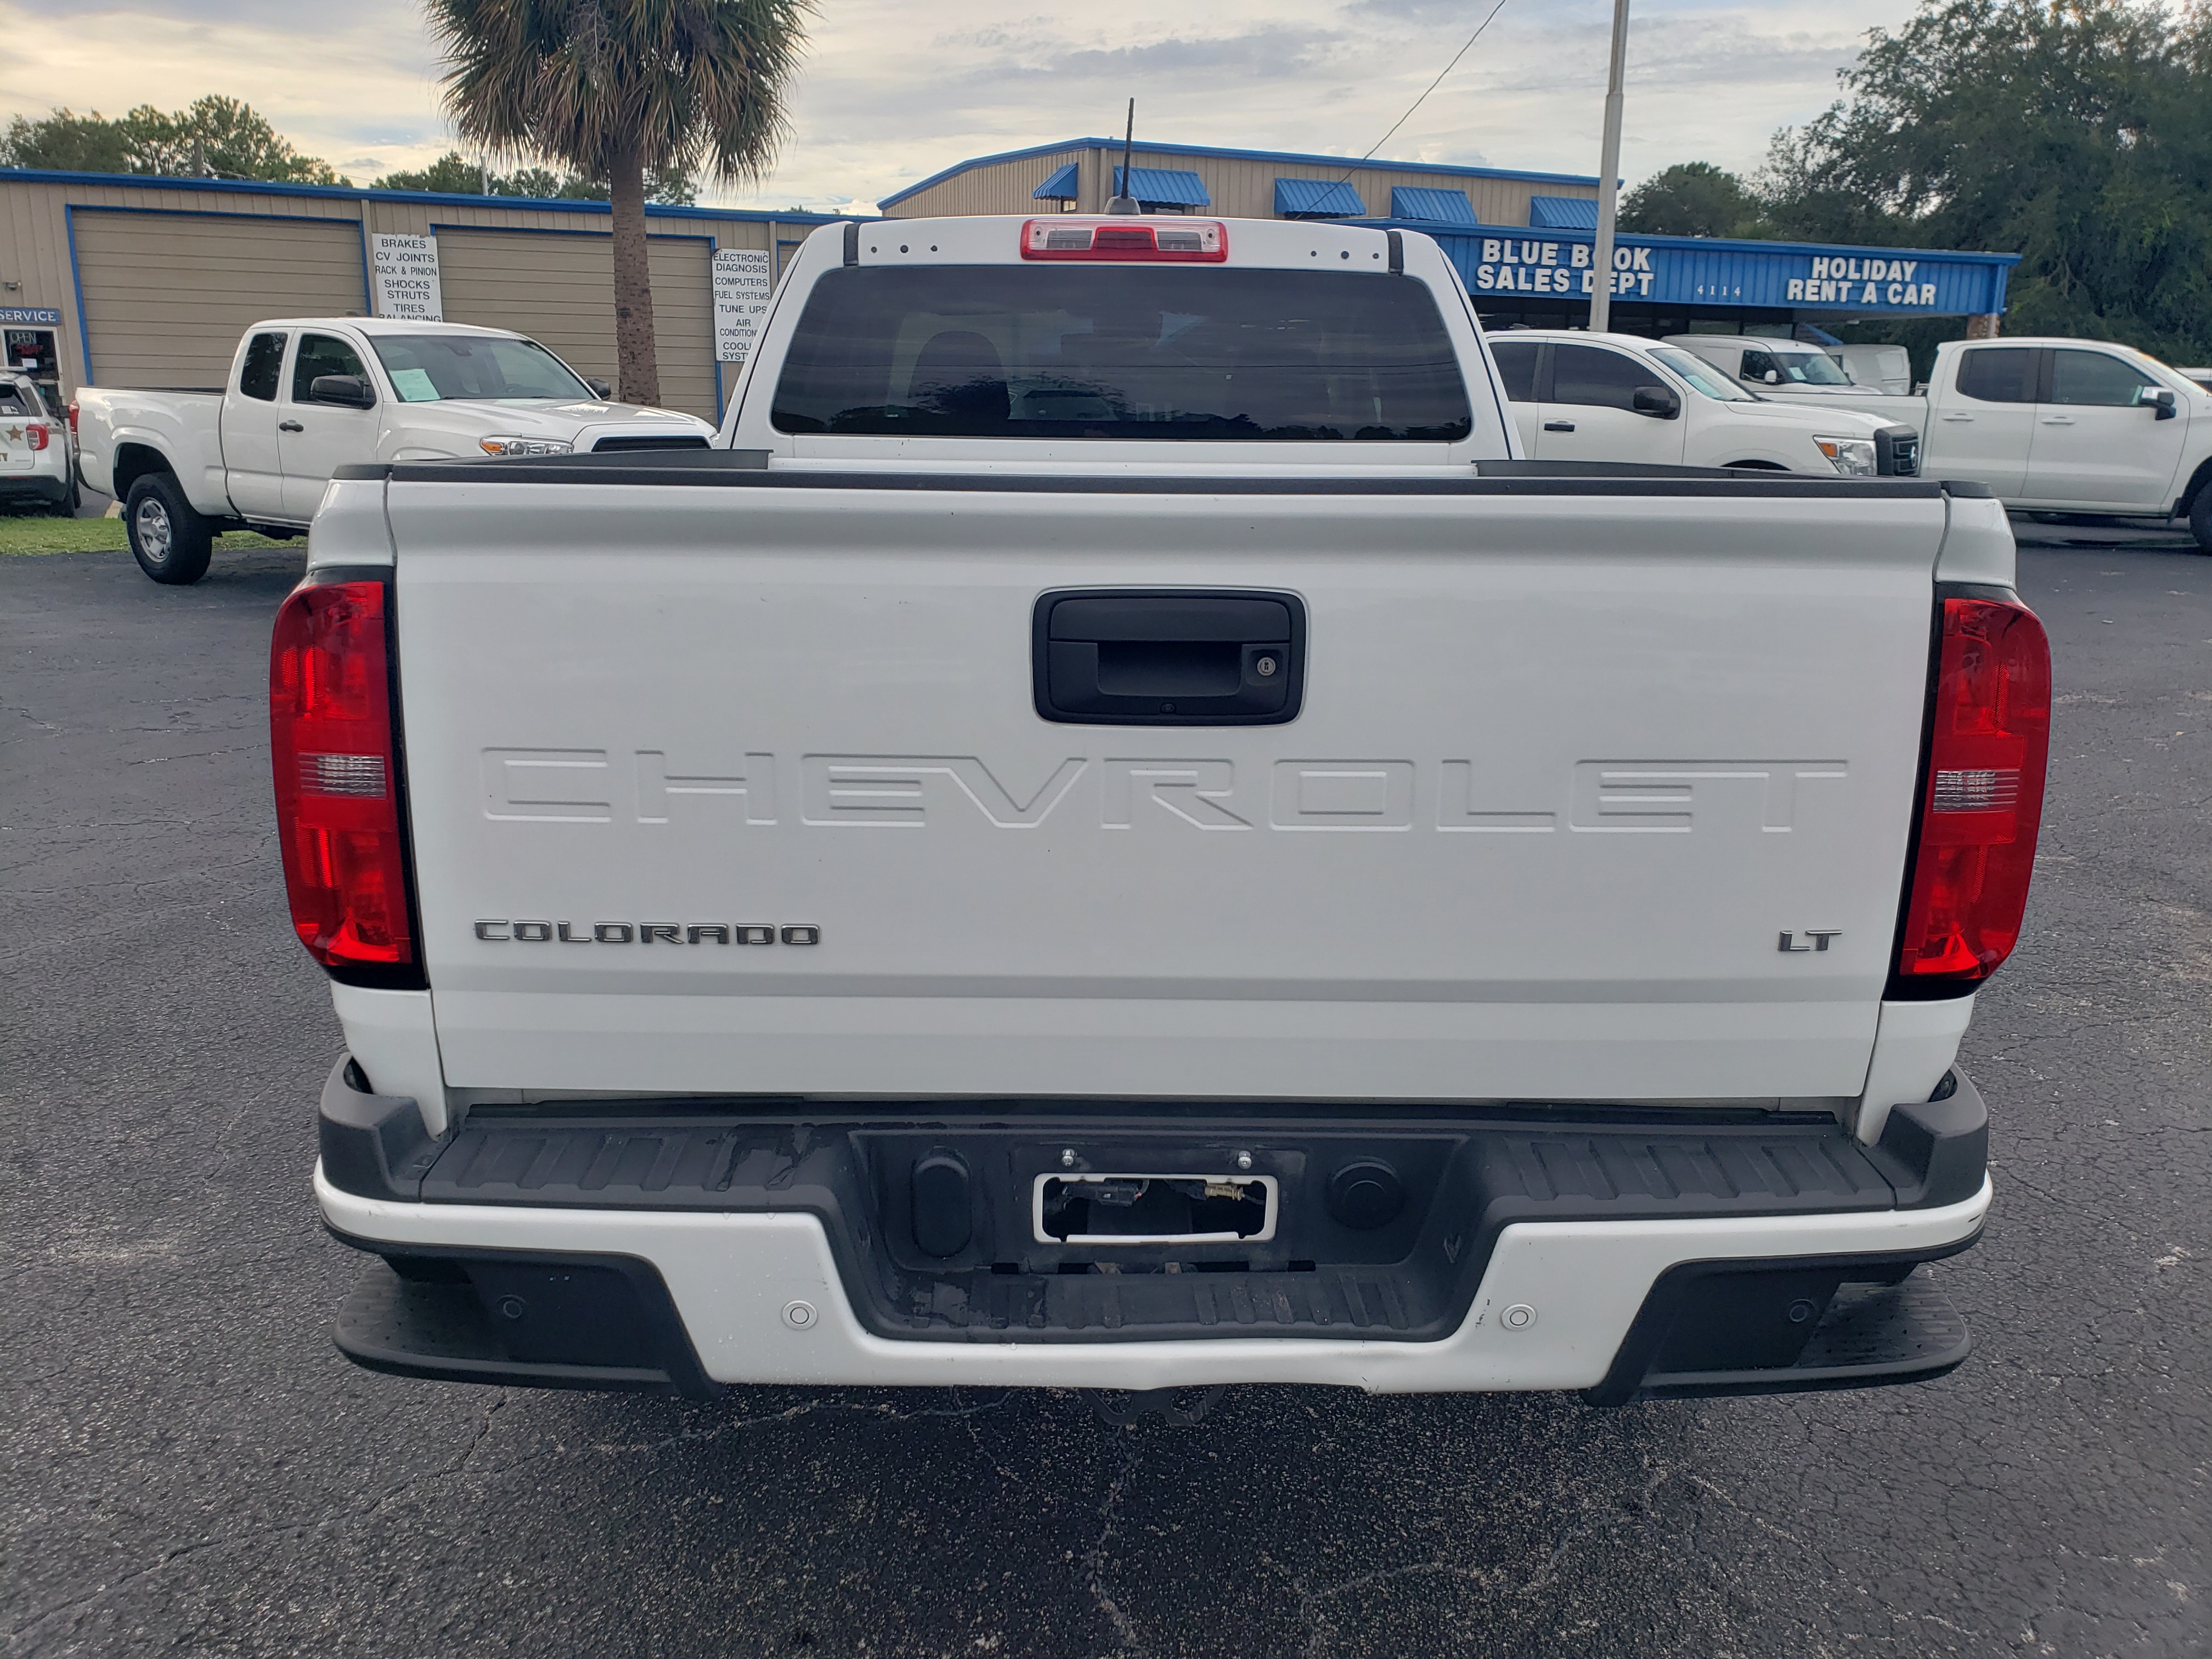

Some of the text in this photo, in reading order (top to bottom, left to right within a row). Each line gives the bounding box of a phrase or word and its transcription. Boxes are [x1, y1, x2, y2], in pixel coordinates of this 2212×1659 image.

[381, 238, 426, 249] BRAKES
[376, 251, 435, 262] CV JOINTS
[714, 253, 769, 263] ELECTRONIC
[1482, 239, 1651, 271] BLUE BOK
[375, 265, 437, 276] RACK & PINION
[716, 263, 768, 273] DIAGNOSIS
[1812, 256, 1918, 281] HOLIDAY
[715, 277, 768, 286] COMPUTERS
[1477, 264, 1570, 292] SALES
[384, 279, 430, 289] SHOCKS
[387, 290, 430, 300] STRUTS
[736, 291, 770, 300] SYSTEMS
[1697, 284, 1740, 297] 4114
[1787, 279, 1937, 305] RENT A CAR
[393, 303, 425, 313] TIRES
[719, 304, 768, 314] TUNE UPS
[0, 310, 56, 321] SERVICE
[736, 319, 751, 327] AIR
[11, 331, 36, 343] OPEN
[719, 328, 758, 337] CONDITION
[723, 352, 749, 360] SYST
[482, 747, 1849, 832] CHEVROLET
[474, 919, 820, 944] COLORADO
[1778, 929, 1843, 951] LT
